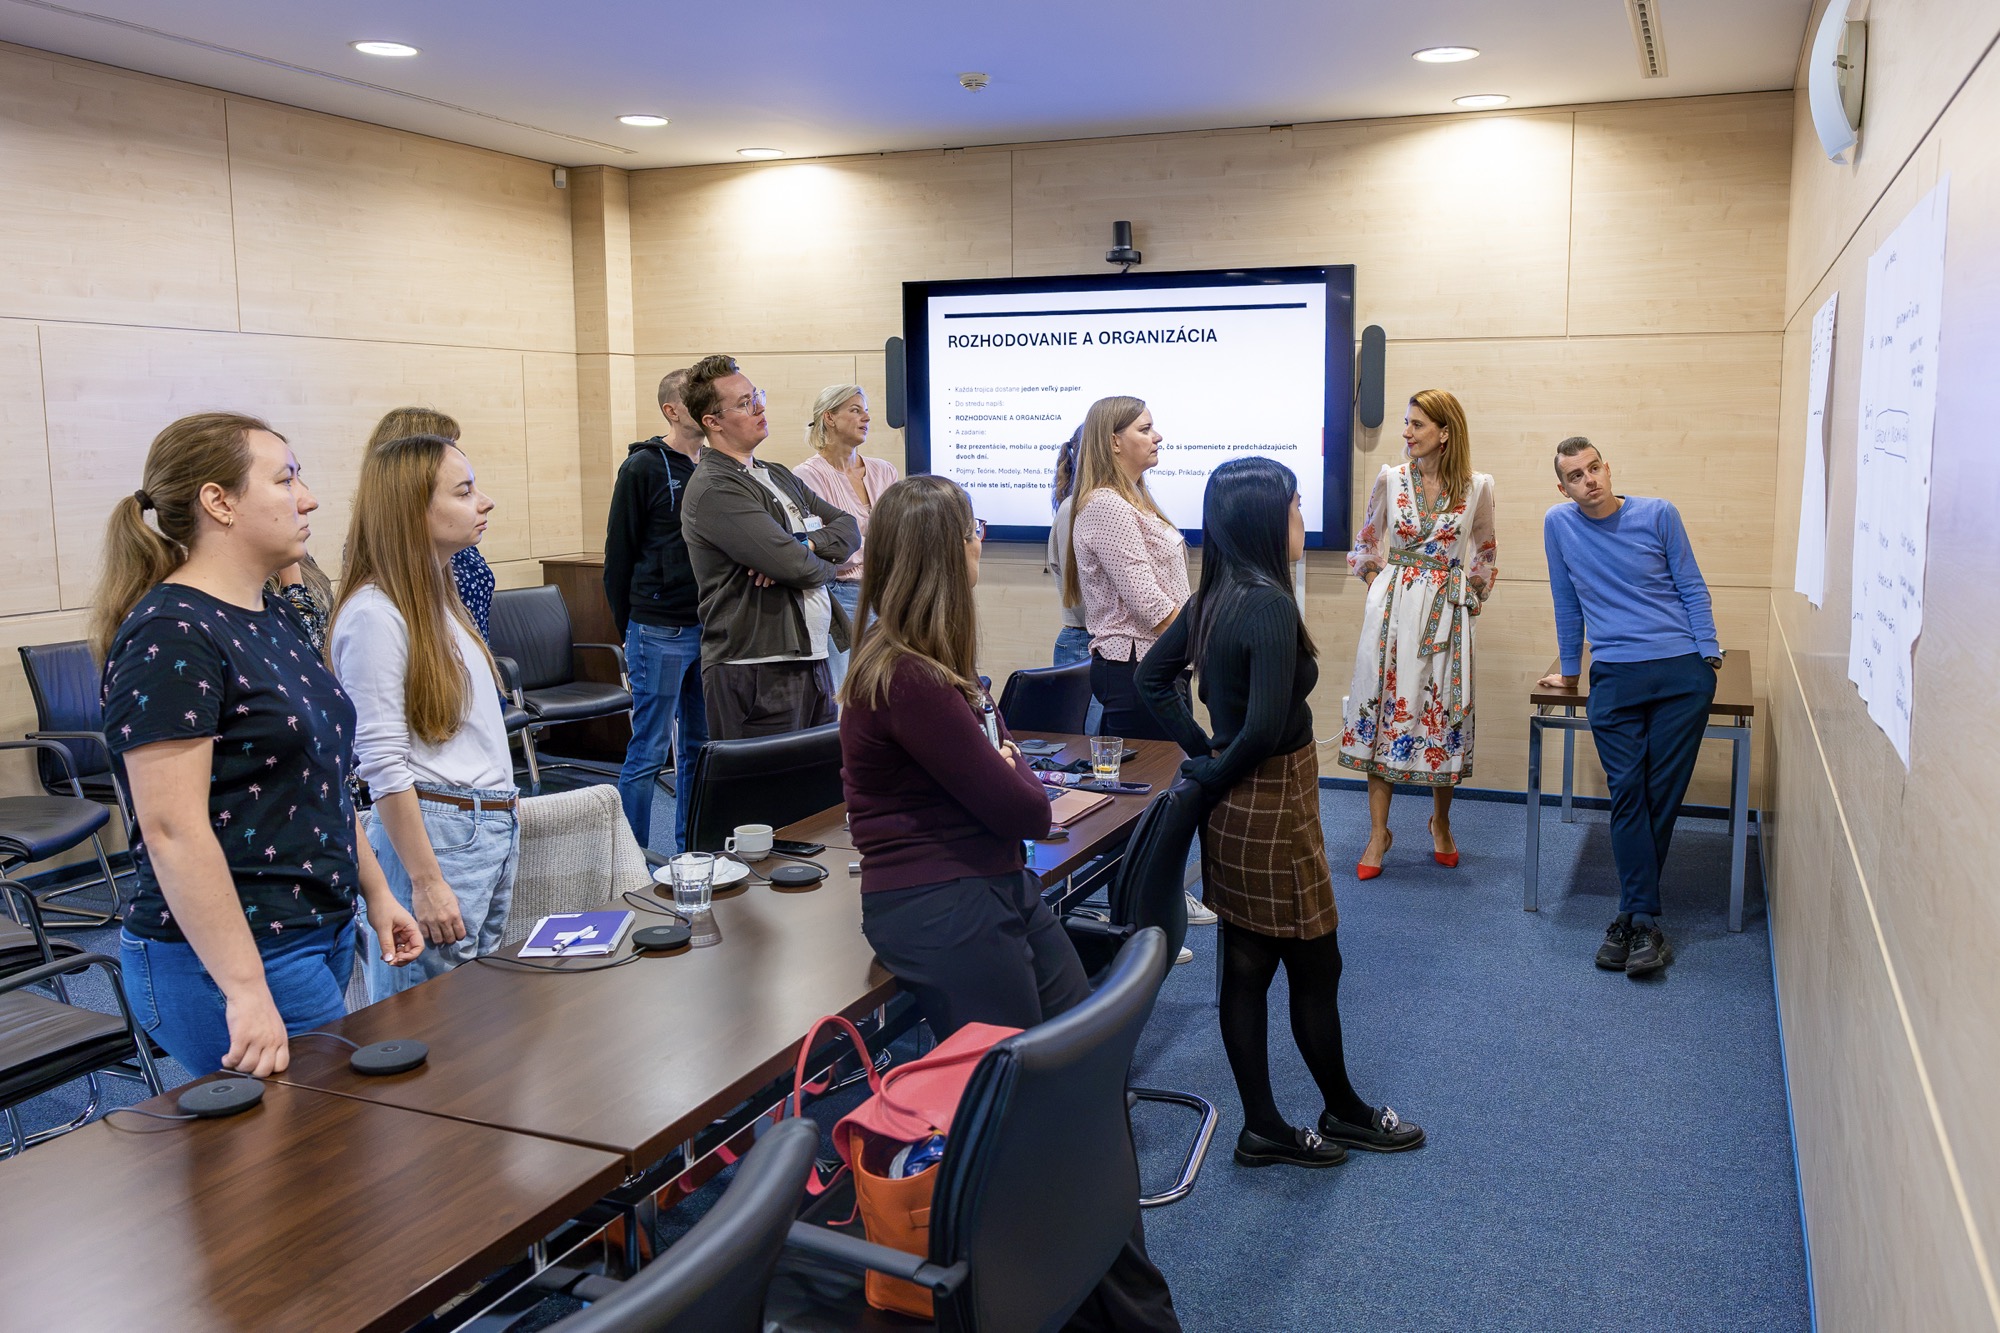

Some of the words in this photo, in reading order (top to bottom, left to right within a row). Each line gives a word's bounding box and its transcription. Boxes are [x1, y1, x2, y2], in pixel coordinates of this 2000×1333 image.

[948, 332, 1078, 348] ROZHODOVANIE
[1082, 331, 1094, 345] A
[1098, 325, 1218, 345] ORGANIZÁCIA
[974, 386, 993, 394] trojica
[1233, 443, 1297, 451] predchádzajúcich
